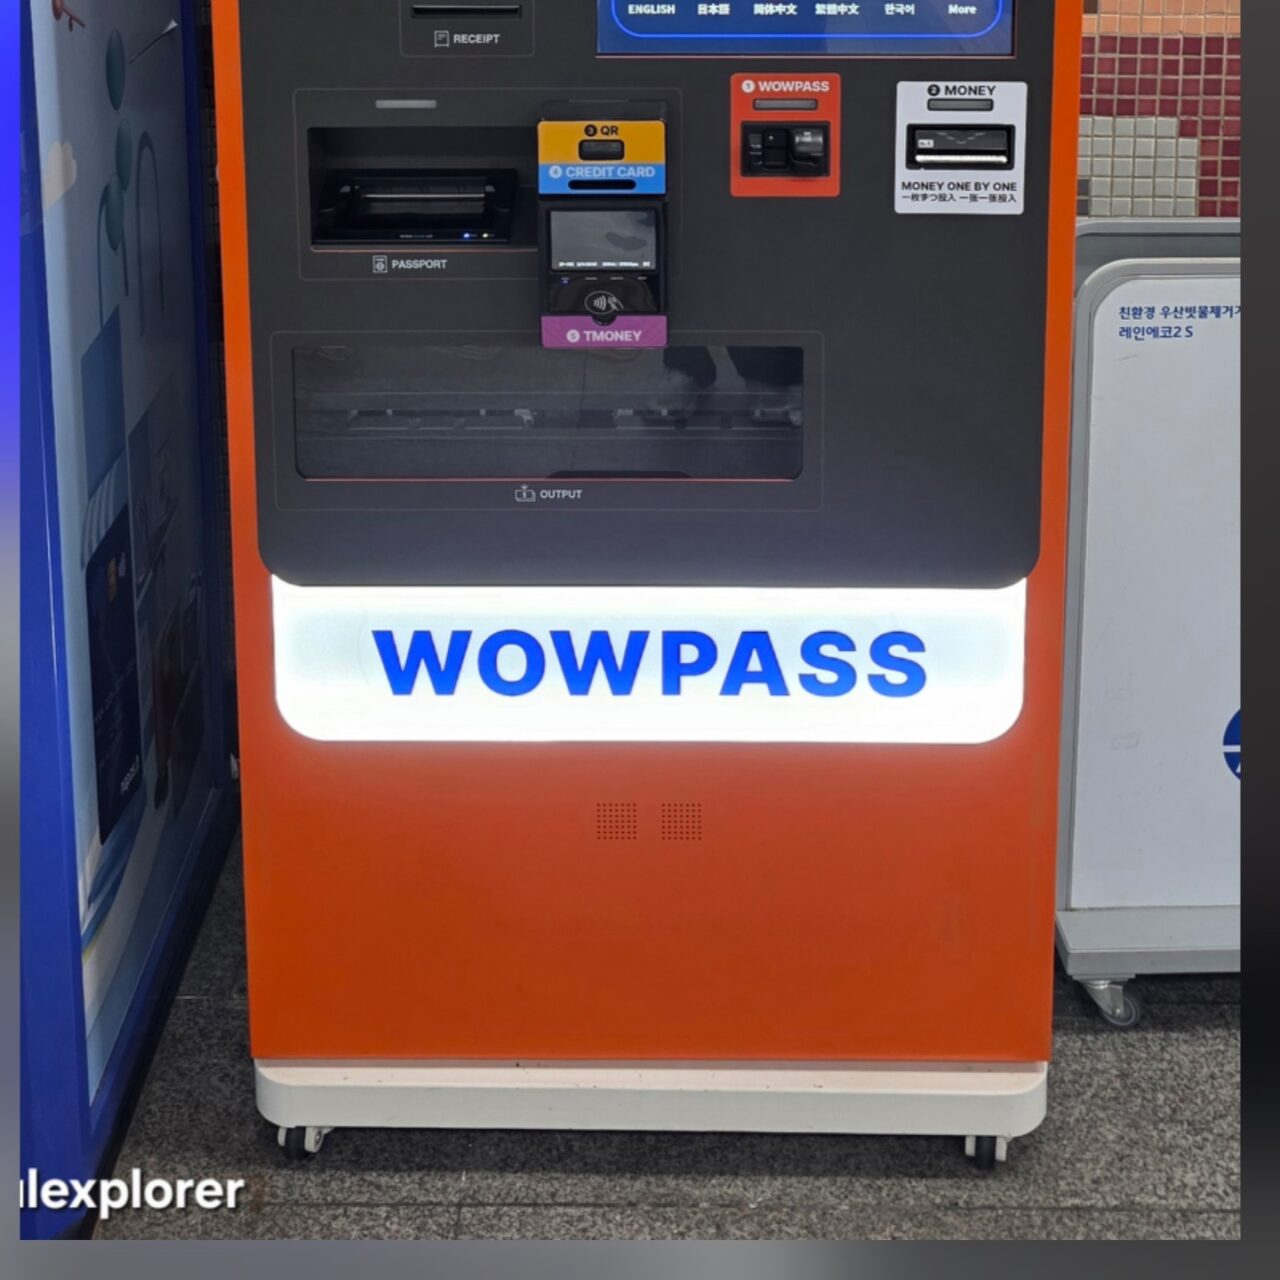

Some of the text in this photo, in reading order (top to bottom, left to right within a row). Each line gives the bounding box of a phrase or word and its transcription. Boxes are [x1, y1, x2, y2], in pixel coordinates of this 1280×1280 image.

[627, 4, 676, 15] ENGLISH
[697, 3, 731, 15] 日本語
[753, 3, 798, 16] 简体中文
[884, 3, 915, 16] 한국어
[947, 4, 977, 15] More
[453, 33, 500, 44] RECEIPT
[758, 81, 830, 92] WOWPASS
[944, 85, 996, 96] MONEY
[600, 125, 619, 136] QR
[565, 166, 656, 178] CREDIT CARD
[901, 181, 1017, 192] MONEY ONE BY ONE
[392, 259, 448, 269] PASSPORT
[1119, 305, 1156, 320] 친환경
[583, 330, 642, 342] TMONEY
[1118, 326, 1194, 341] 레인에코2 S
[540, 489, 583, 499] OUTPUT
[371, 629, 928, 699] WOWPASS
